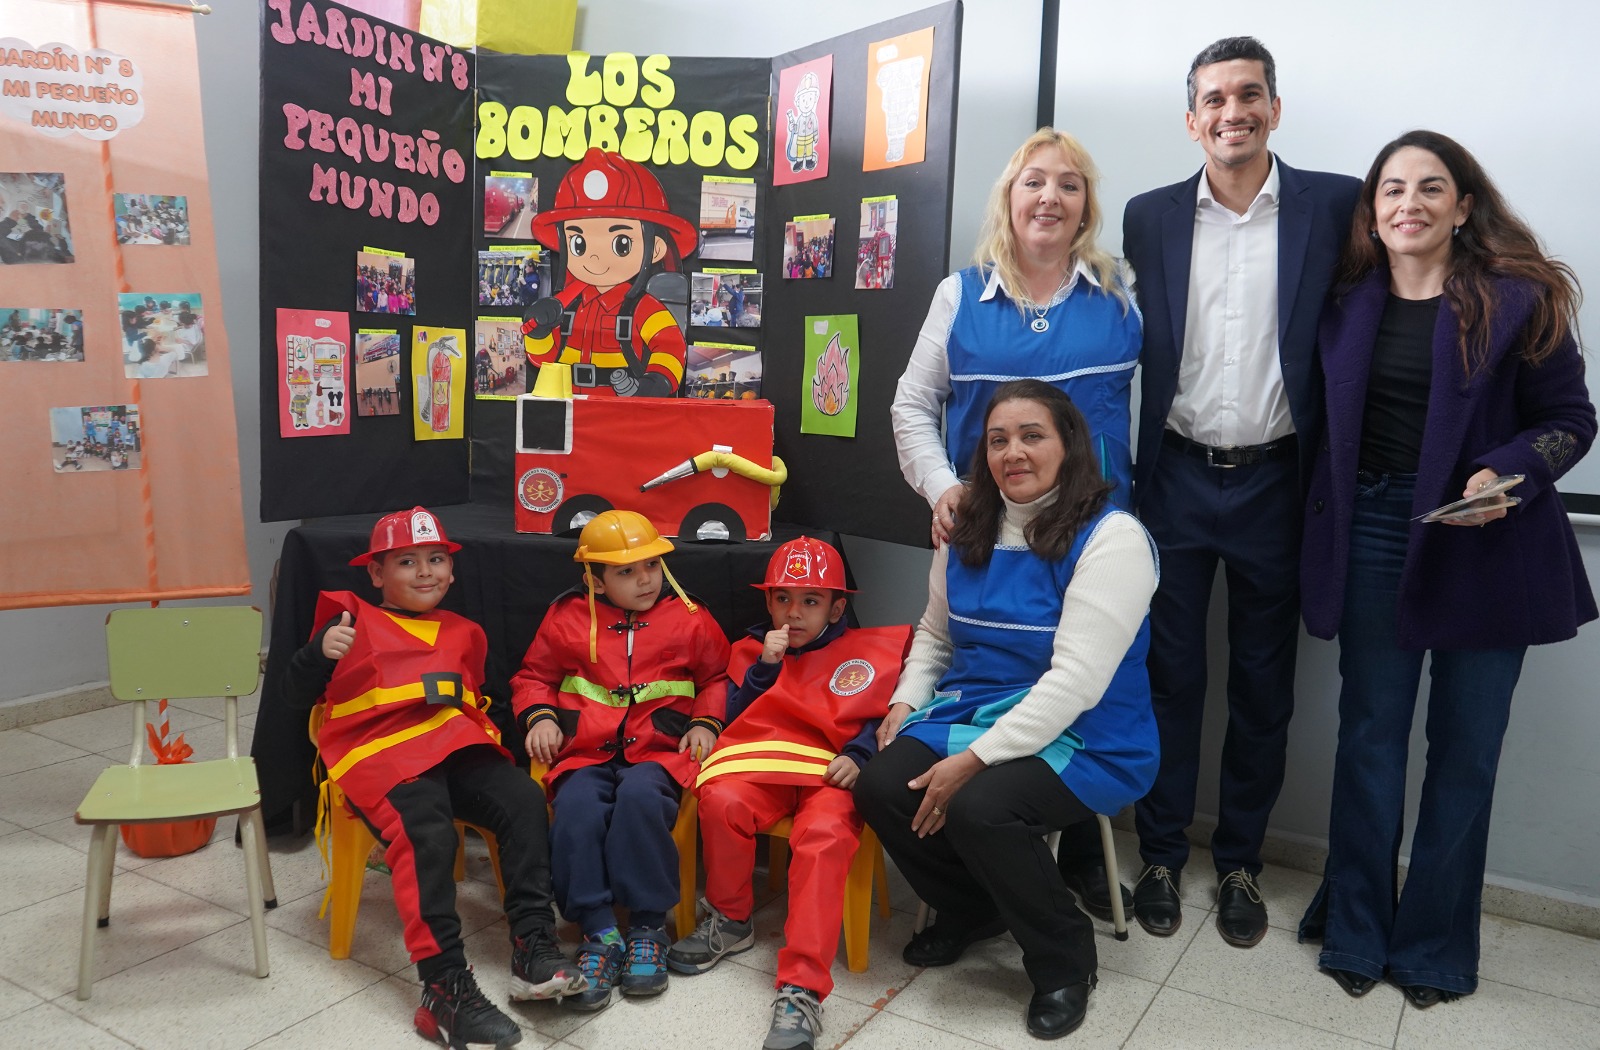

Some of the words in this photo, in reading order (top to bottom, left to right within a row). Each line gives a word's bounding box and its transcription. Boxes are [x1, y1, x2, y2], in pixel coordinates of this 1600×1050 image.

[0, 47, 79, 72] JARDÍN
[118, 58, 134, 78] 8
[268, 0, 415, 73] JARDIN
[3, 79, 31, 98] MI
[36, 81, 139, 105] PEQUEÑO
[349, 67, 393, 116] MI
[565, 51, 676, 109] LOS
[31, 109, 118, 132] MUNDO
[282, 102, 466, 184] PEQUEÑO
[475, 101, 759, 171] BOMBEROS
[308, 162, 440, 226] MUNDO
